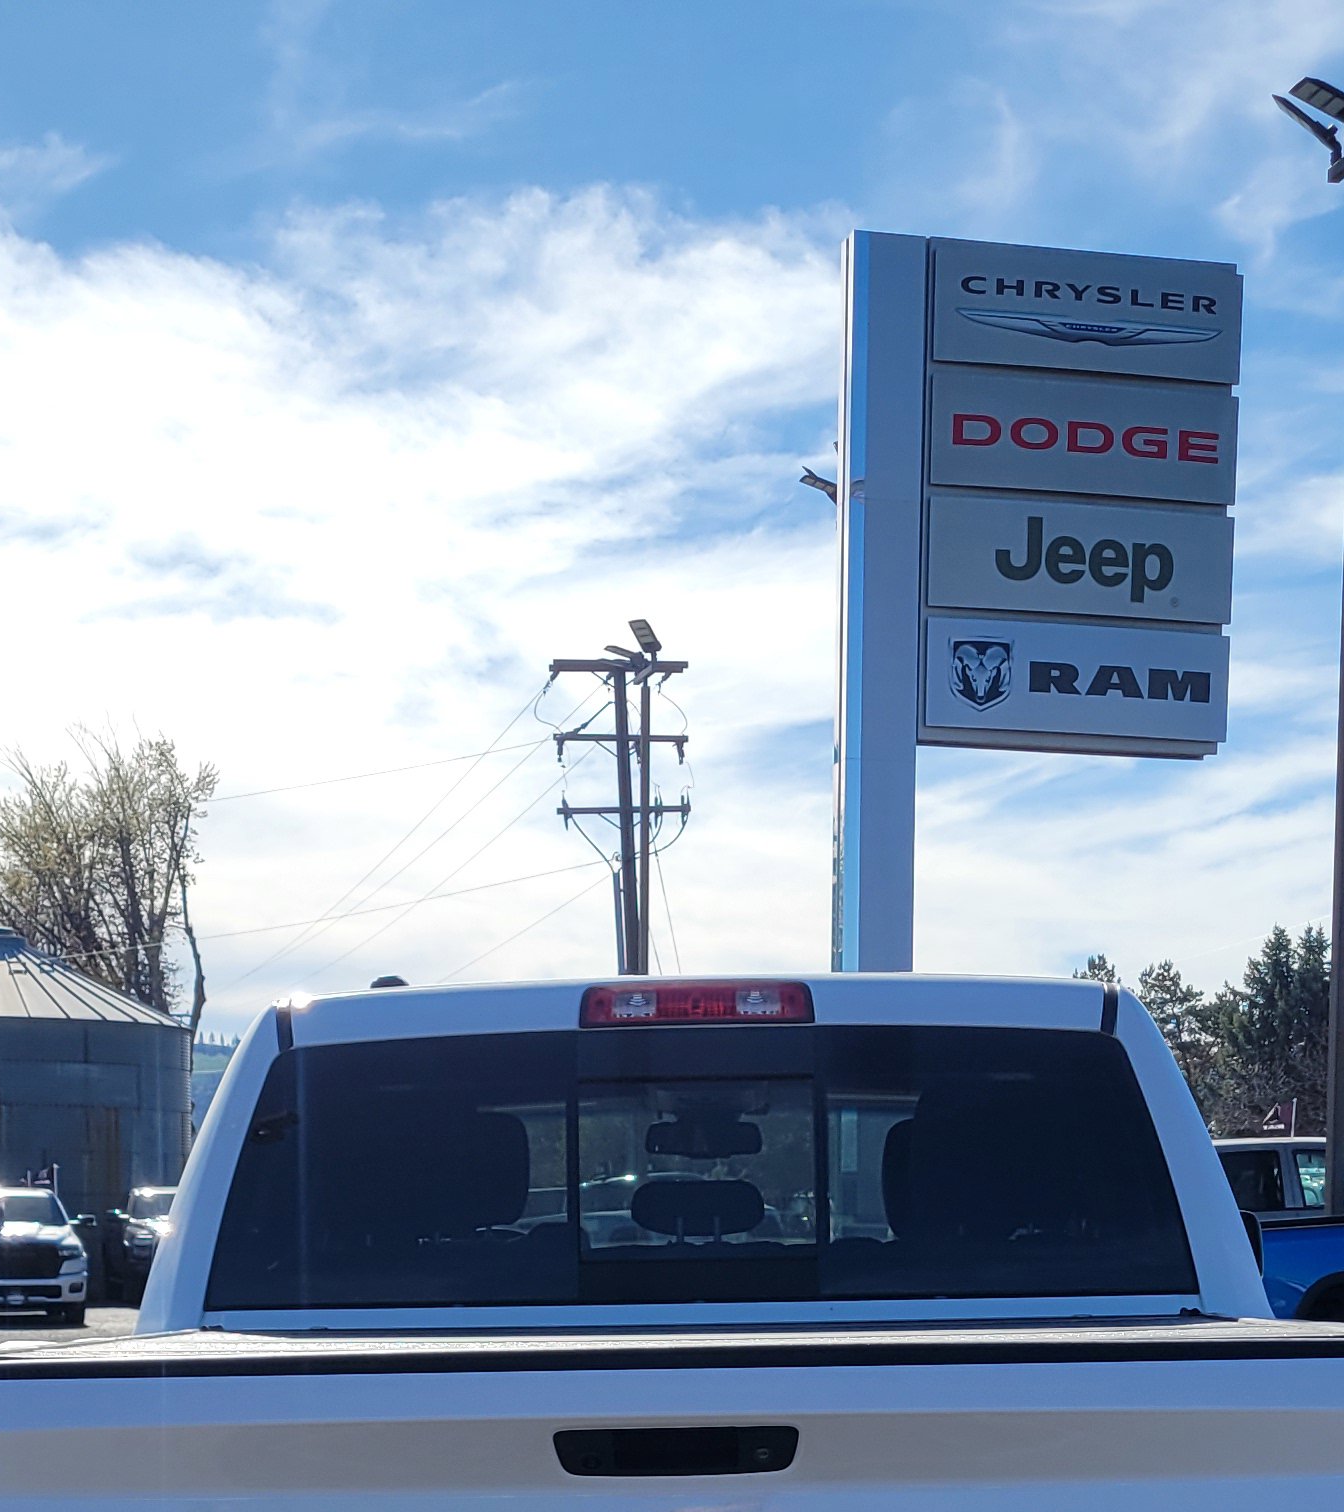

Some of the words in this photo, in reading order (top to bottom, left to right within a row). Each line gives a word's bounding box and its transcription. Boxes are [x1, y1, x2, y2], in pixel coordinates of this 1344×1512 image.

[960, 275, 1218, 315] CHRYSLER
[952, 413, 1219, 465] DODGE
[995, 516, 1174, 603] Jeep
[1028, 660, 1211, 703] RAM
